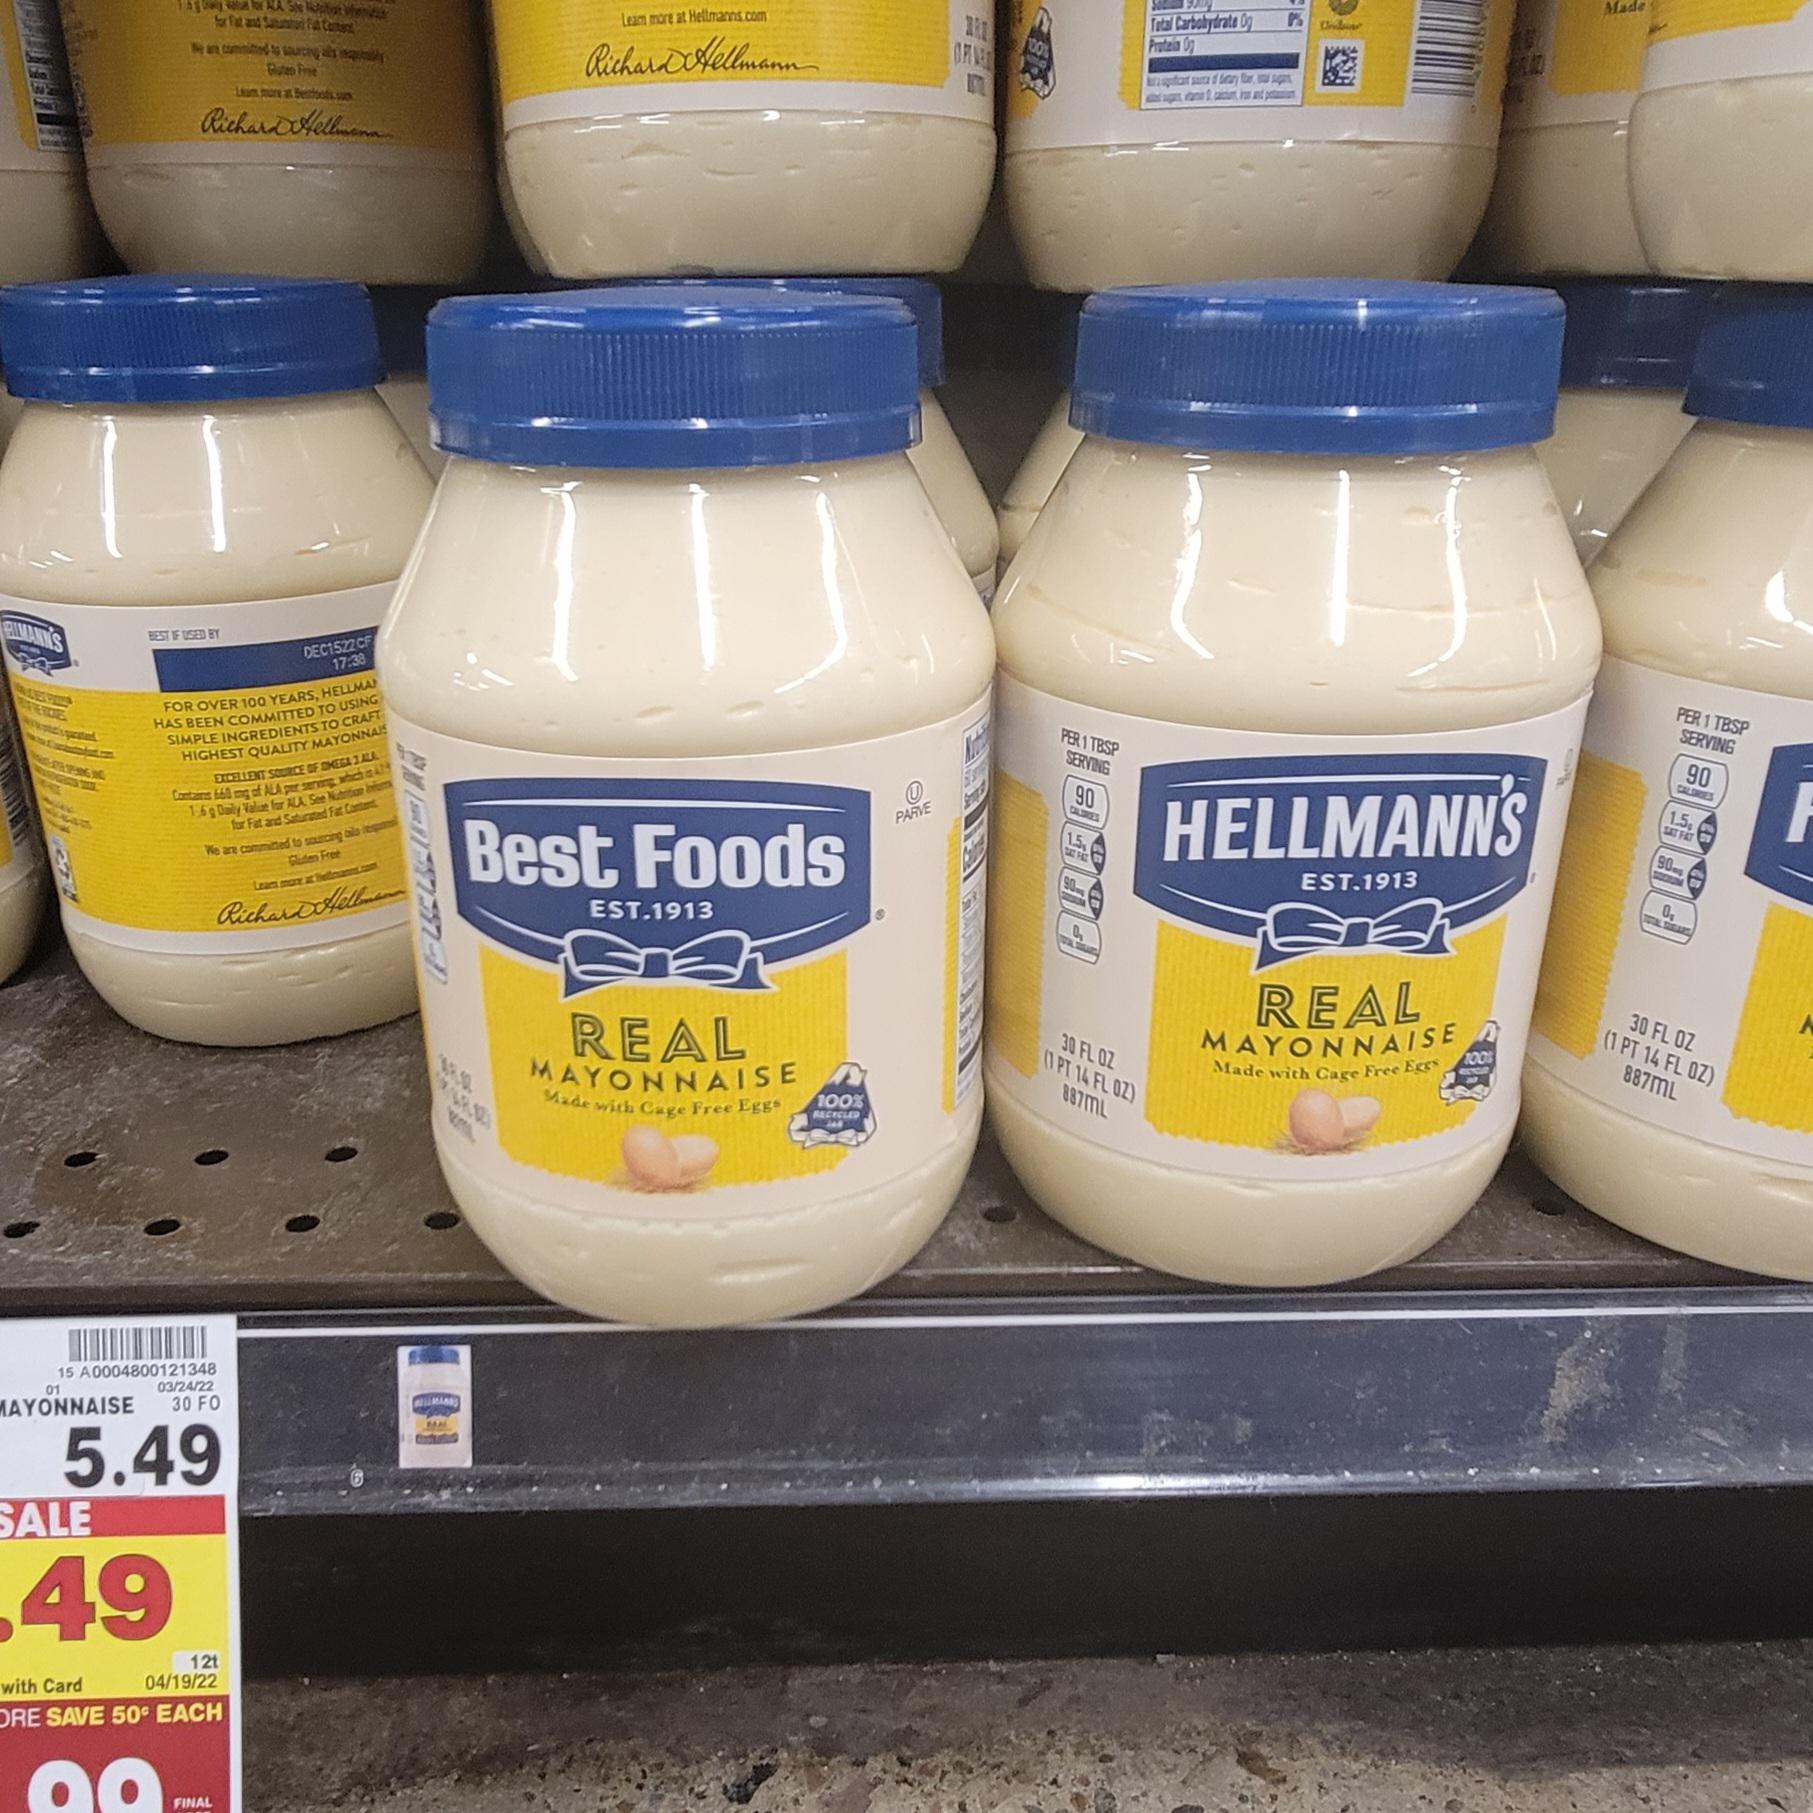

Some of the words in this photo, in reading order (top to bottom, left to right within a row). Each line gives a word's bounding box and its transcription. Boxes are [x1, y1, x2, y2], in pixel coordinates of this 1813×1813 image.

[622, 13, 647, 27] Learn
[649, 13, 674, 25] more
[676, 11, 687, 23] at
[585, 42, 690, 78] Richard
[691, 35, 819, 73] Hellmann
[148, 631, 170, 641] BEST
[208, 629, 220, 639] BY
[154, 718, 183, 729] HAS
[187, 716, 224, 728] BEEN
[228, 703, 315, 726] COMMITTED
[319, 703, 336, 715] TO
[340, 694, 379, 711] USING
[164, 701, 193, 712] FOR
[197, 698, 238, 712] OVER
[242, 697, 266, 708] 100
[270, 690, 320, 706] YEARS,
[167, 732, 219, 745] SIMPLE
[222, 719, 319, 742] INGREDIENTS
[321, 719, 339, 731] TO
[342, 709, 381, 727] CRAFT
[1676, 706, 1701, 726] PER
[1704, 714, 1710, 728] 1
[1714, 715, 1750, 735] TBSP
[182, 746, 244, 761] HIGHEST
[247, 741, 308, 759] QUALITY
[1061, 728, 1080, 748] PER
[1083, 735, 1087, 750] 1
[1090, 736, 1120, 757] TBSP
[1680, 729, 1736, 755] SERVING
[1066, 750, 1110, 776] SERVING
[1686, 764, 1711, 788] 90
[1075, 785, 1094, 809] 90
[247, 817, 263, 829] Fat
[265, 815, 282, 828] and
[895, 801, 932, 824] PARVE
[1163, 773, 1528, 861] HELLMANN'S
[223, 844, 238, 855] are
[292, 836, 302, 847] to
[463, 818, 619, 888] Best
[633, 823, 846, 888] Foods
[1300, 871, 1418, 892] EST.1913
[217, 901, 317, 925] Richard
[589, 899, 714, 920] EST.1913
[1256, 981, 1420, 1030] REAL
[571, 1012, 746, 1063] REAL
[1201, 1022, 1456, 1058] MAYONNAISE
[1630, 1013, 1648, 1036] 30
[1652, 1021, 1669, 1045] FL
[1674, 1029, 1696, 1052] OZ
[1062, 1033, 1076, 1055] 30
[1080, 1040, 1095, 1063] FL
[1098, 1048, 1115, 1070] OZ
[1604, 1029, 1617, 1051] (1
[1620, 1036, 1640, 1059] PT
[1644, 1046, 1659, 1068] 14
[1664, 1053, 1682, 1076] FL
[1688, 1061, 1715, 1087] OZ)
[530, 1056, 797, 1092] MAYONNAISE
[1044, 1049, 1054, 1070] (1
[1057, 1055, 1071, 1078] PT
[1076, 1064, 1089, 1086] 14
[1093, 1071, 1108, 1094] FL
[1113, 1078, 1135, 1104] OZ)
[1213, 1059, 1264, 1078] Made
[1268, 1062, 1310, 1080] with
[1315, 1067, 1359, 1083] Cage
[1364, 1063, 1400, 1079] Free
[1404, 1057, 1440, 1075] Eggs
[1623, 1064, 1677, 1101] 887mL
[545, 1089, 590, 1109] Made
[595, 1098, 634, 1114] with
[640, 1102, 686, 1119] Cage
[692, 1101, 732, 1115] Free
[738, 1098, 781, 1115] Eggs
[817, 1093, 864, 1109] 100%
[1063, 1083, 1108, 1119] 887mL
[58, 1367, 74, 1379] 15
[46, 1384, 60, 1395] 01
[157, 1381, 214, 1393] 03/24/22
[172, 1396, 191, 1412] 30
[198, 1395, 221, 1411] FO
[64, 1423, 221, 1488] 5.49
[0, 1501, 92, 1538] SALE
[1, 1678, 37, 1695] with
[43, 1677, 82, 1693] Card
[145, 1674, 217, 1690] 04/19/22
[47, 1706, 104, 1726] SAVE
[157, 1702, 223, 1723] EACH
[174, 1797, 213, 1809] FINAL
